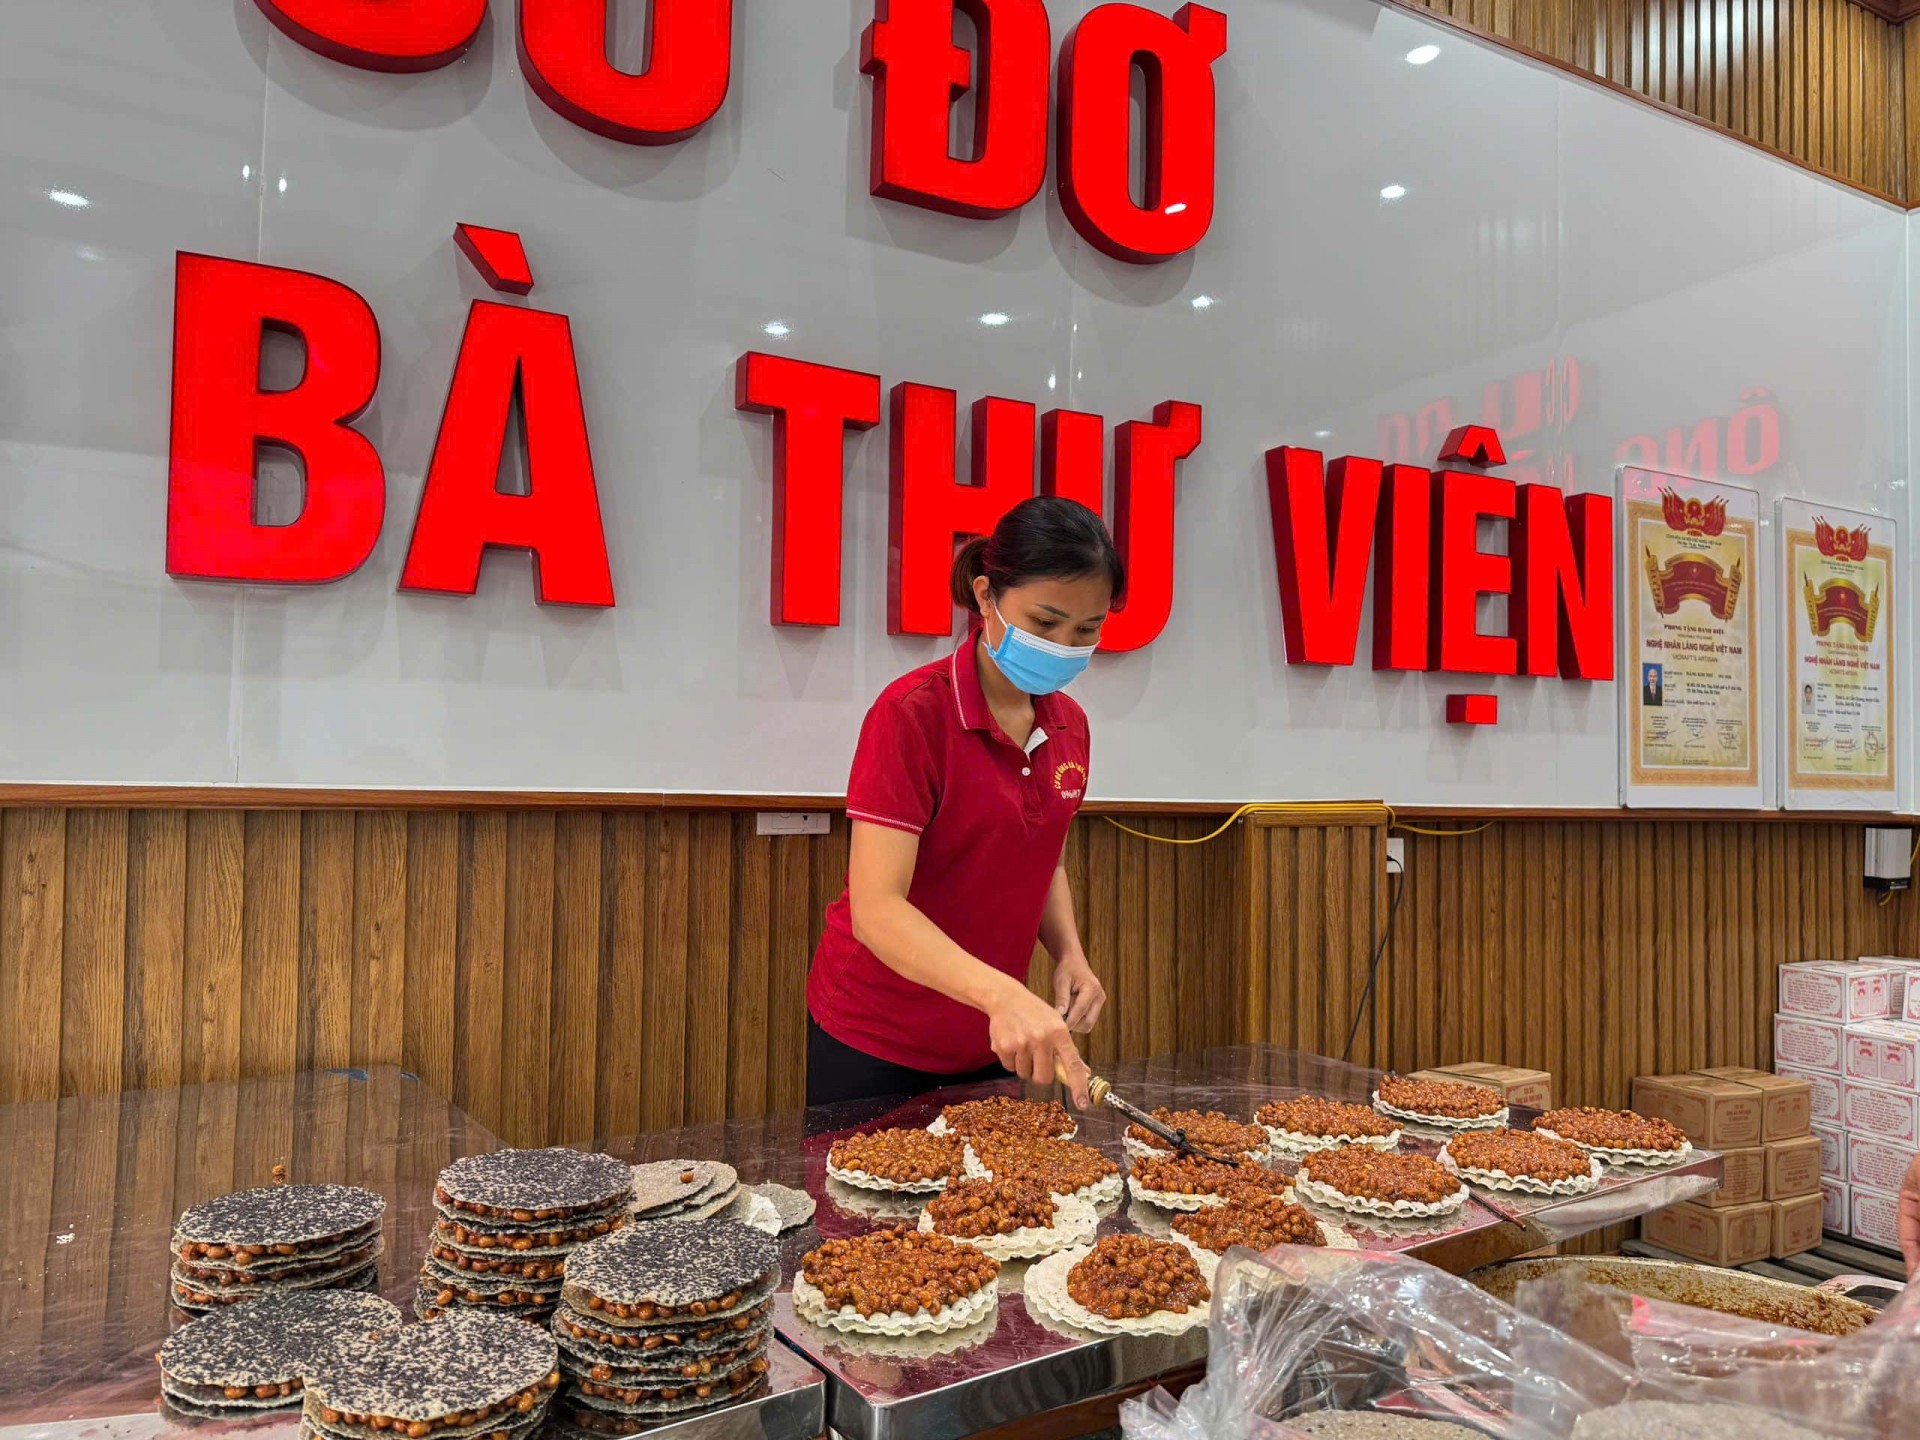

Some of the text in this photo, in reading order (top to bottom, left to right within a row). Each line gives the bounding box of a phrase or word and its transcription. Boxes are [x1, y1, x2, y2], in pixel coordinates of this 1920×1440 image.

[860, 0, 1227, 265] ĐƠ
[166, 222, 1613, 724] BÀ THƯ VIỆN
[1646, 639, 1743, 655] NGHỆ NHÂN LÀNG NGHỀ VIỆT NAM
